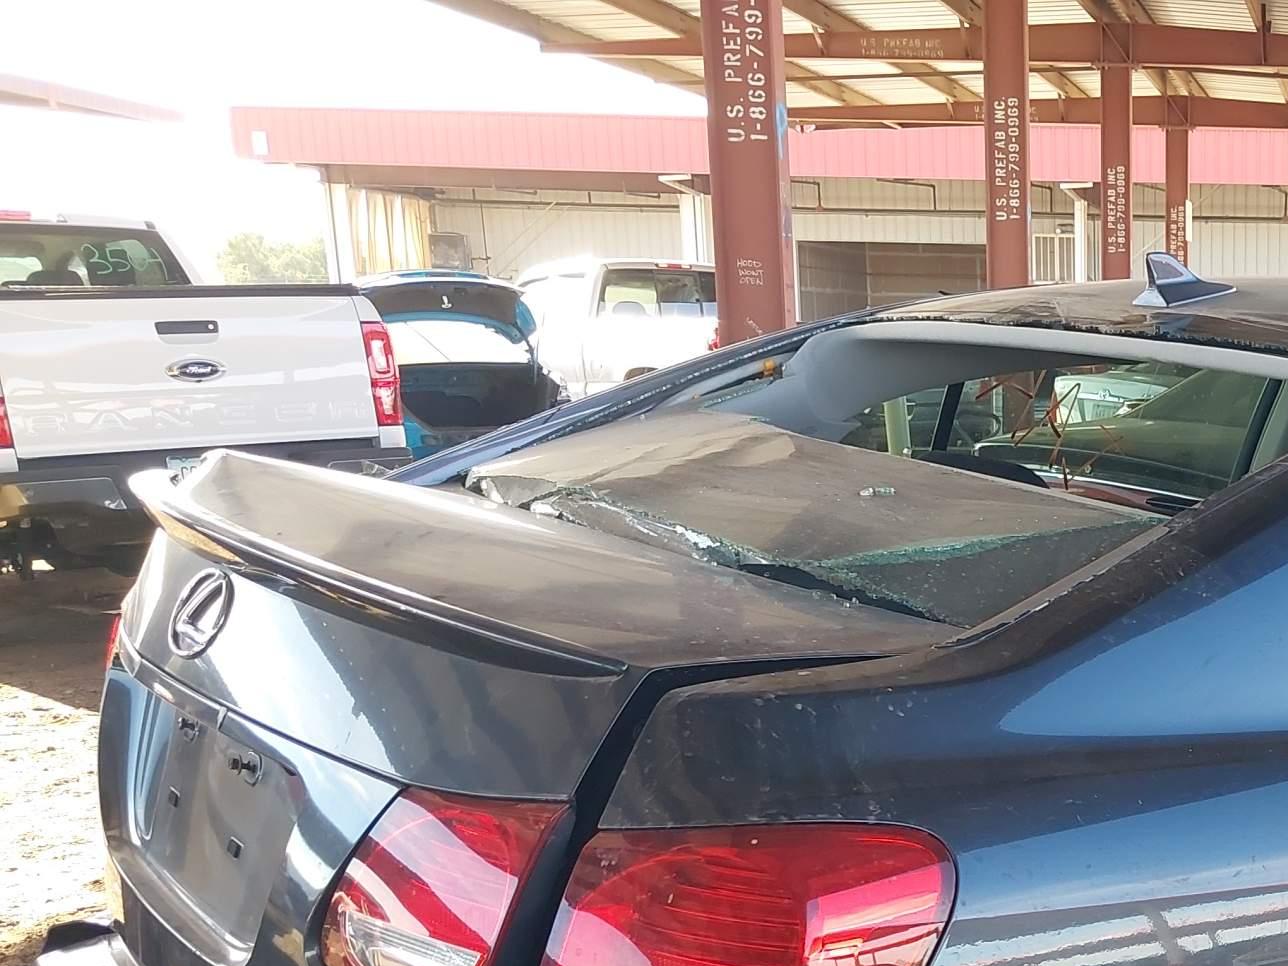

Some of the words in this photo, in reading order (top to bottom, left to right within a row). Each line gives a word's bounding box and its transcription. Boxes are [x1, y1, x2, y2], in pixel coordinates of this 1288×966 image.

[726, 97, 746, 142] U.S.
[993, 96, 1006, 124] INC.
[994, 130, 1007, 186] PREFAB
[1007, 97, 1021, 220] 1-866-799-0969
[994, 193, 1007, 221] U.S.
[1107, 189, 1117, 229] PREFAB
[736, 257, 763, 268] HOOD
